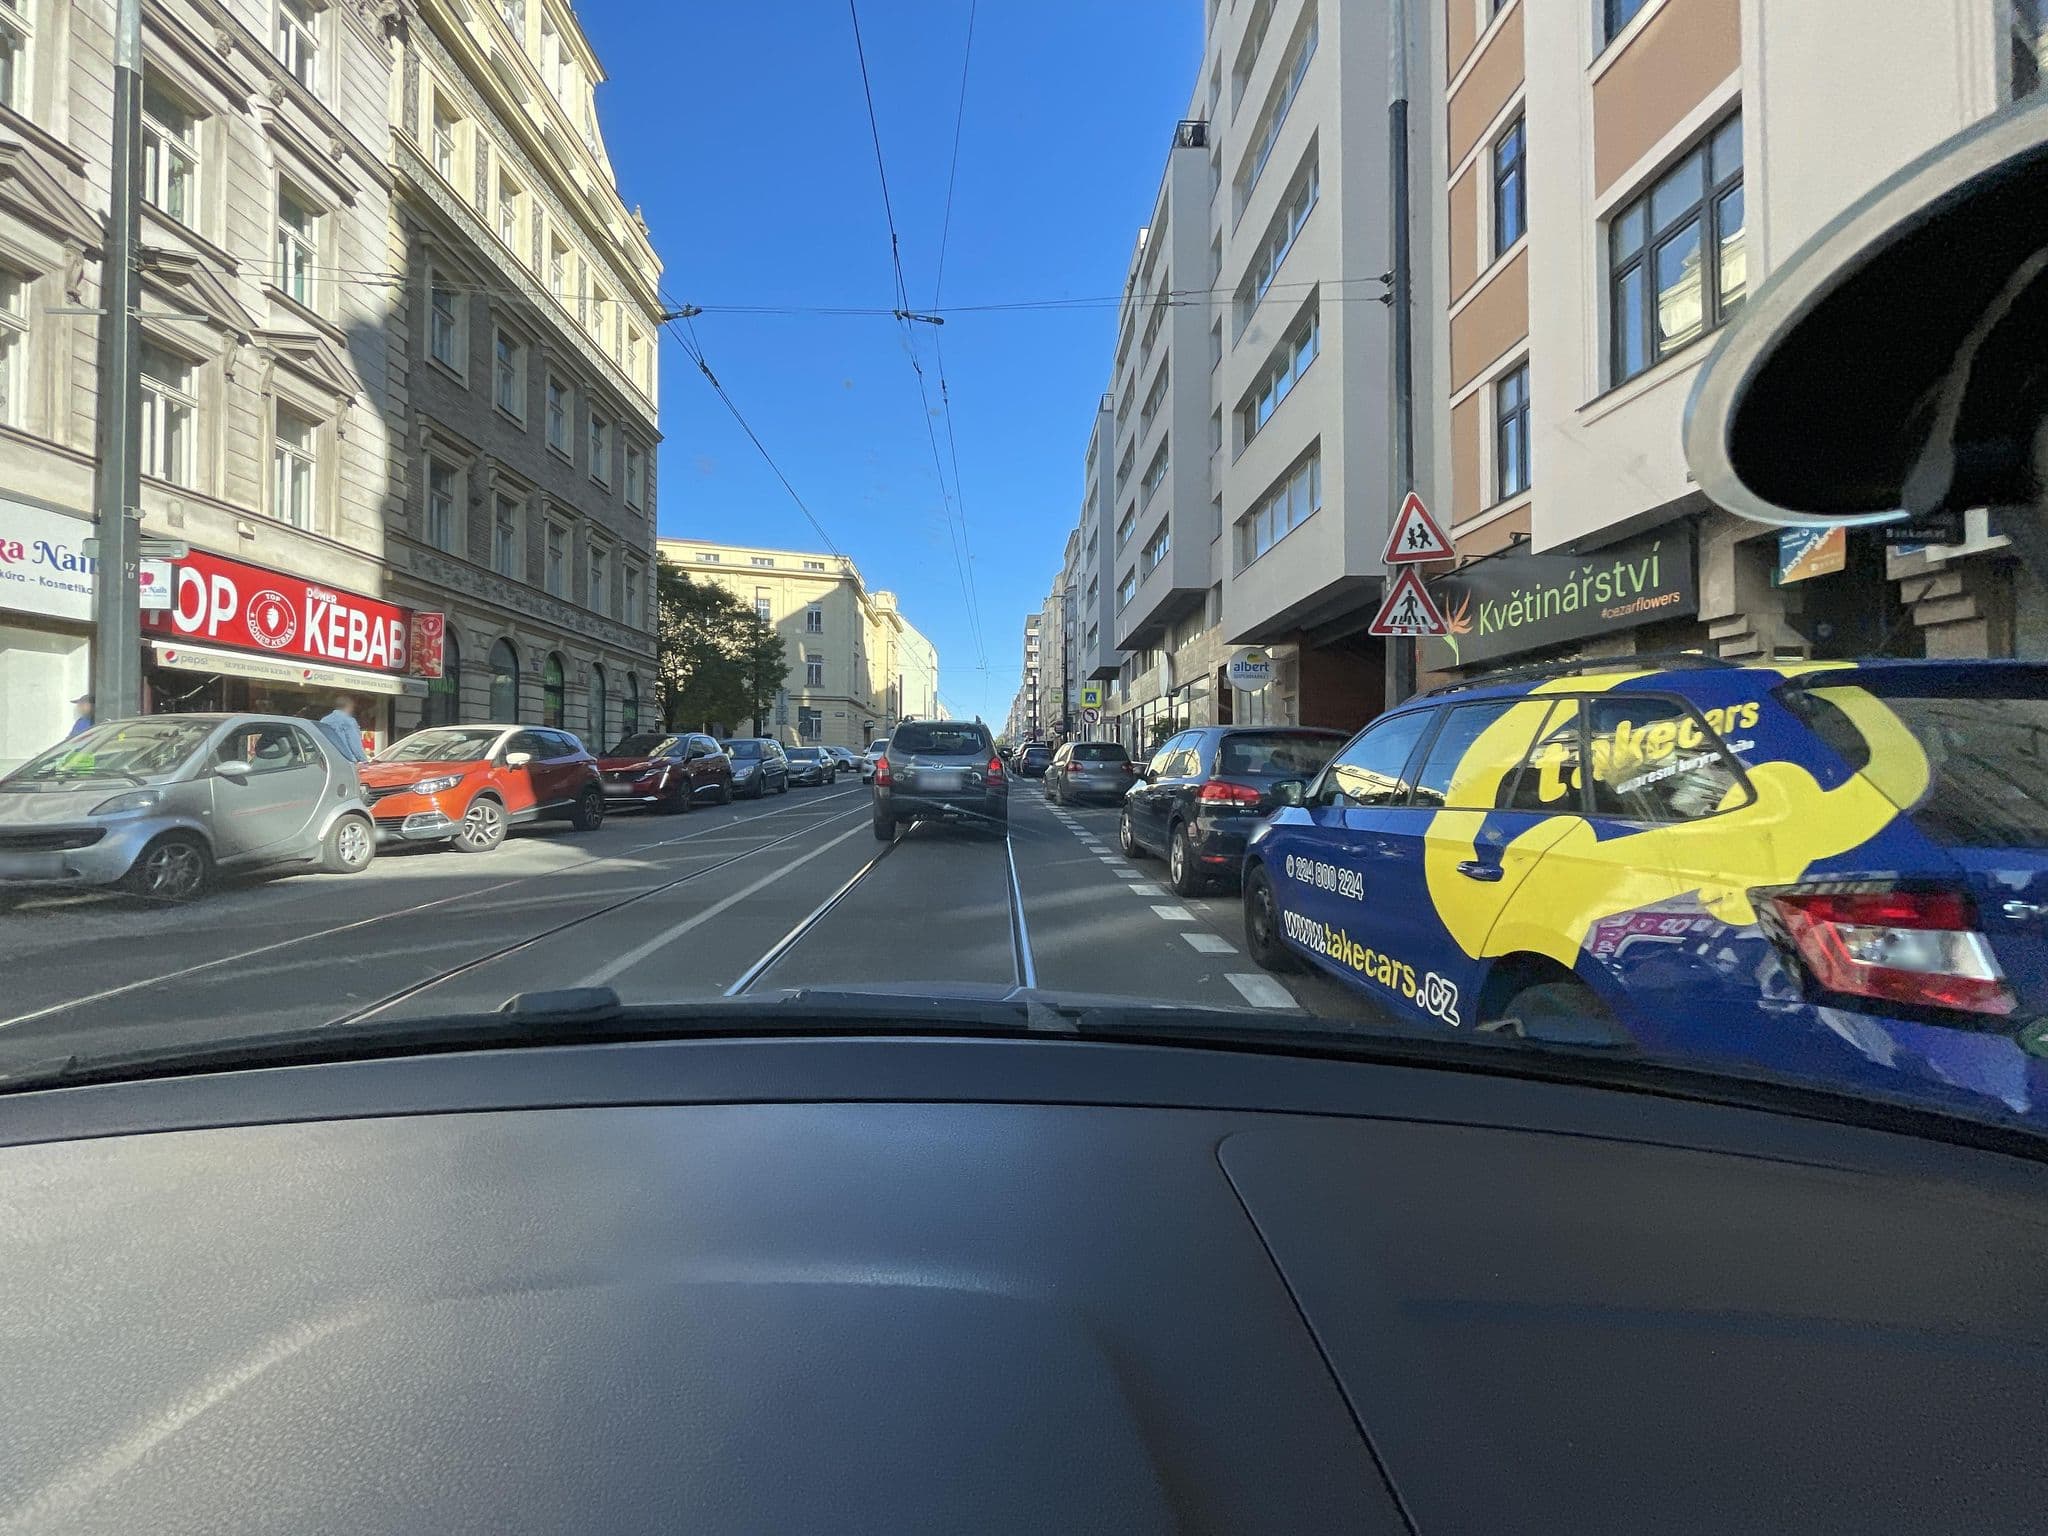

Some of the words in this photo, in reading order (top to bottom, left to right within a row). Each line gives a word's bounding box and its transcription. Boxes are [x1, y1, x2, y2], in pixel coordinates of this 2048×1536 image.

[265, 593, 281, 602] TOP
[1479, 540, 1661, 637] Květinářství
[303, 597, 406, 669] KEBAB
[180, 655, 208, 665] pepsi
[1233, 661, 1270, 672] albert
[313, 672, 335, 681] pepsi
[1536, 702, 1760, 803] takecars
[1295, 857, 1314, 885] 224
[1316, 862, 1336, 892] 800
[1338, 868, 1364, 901] 224
